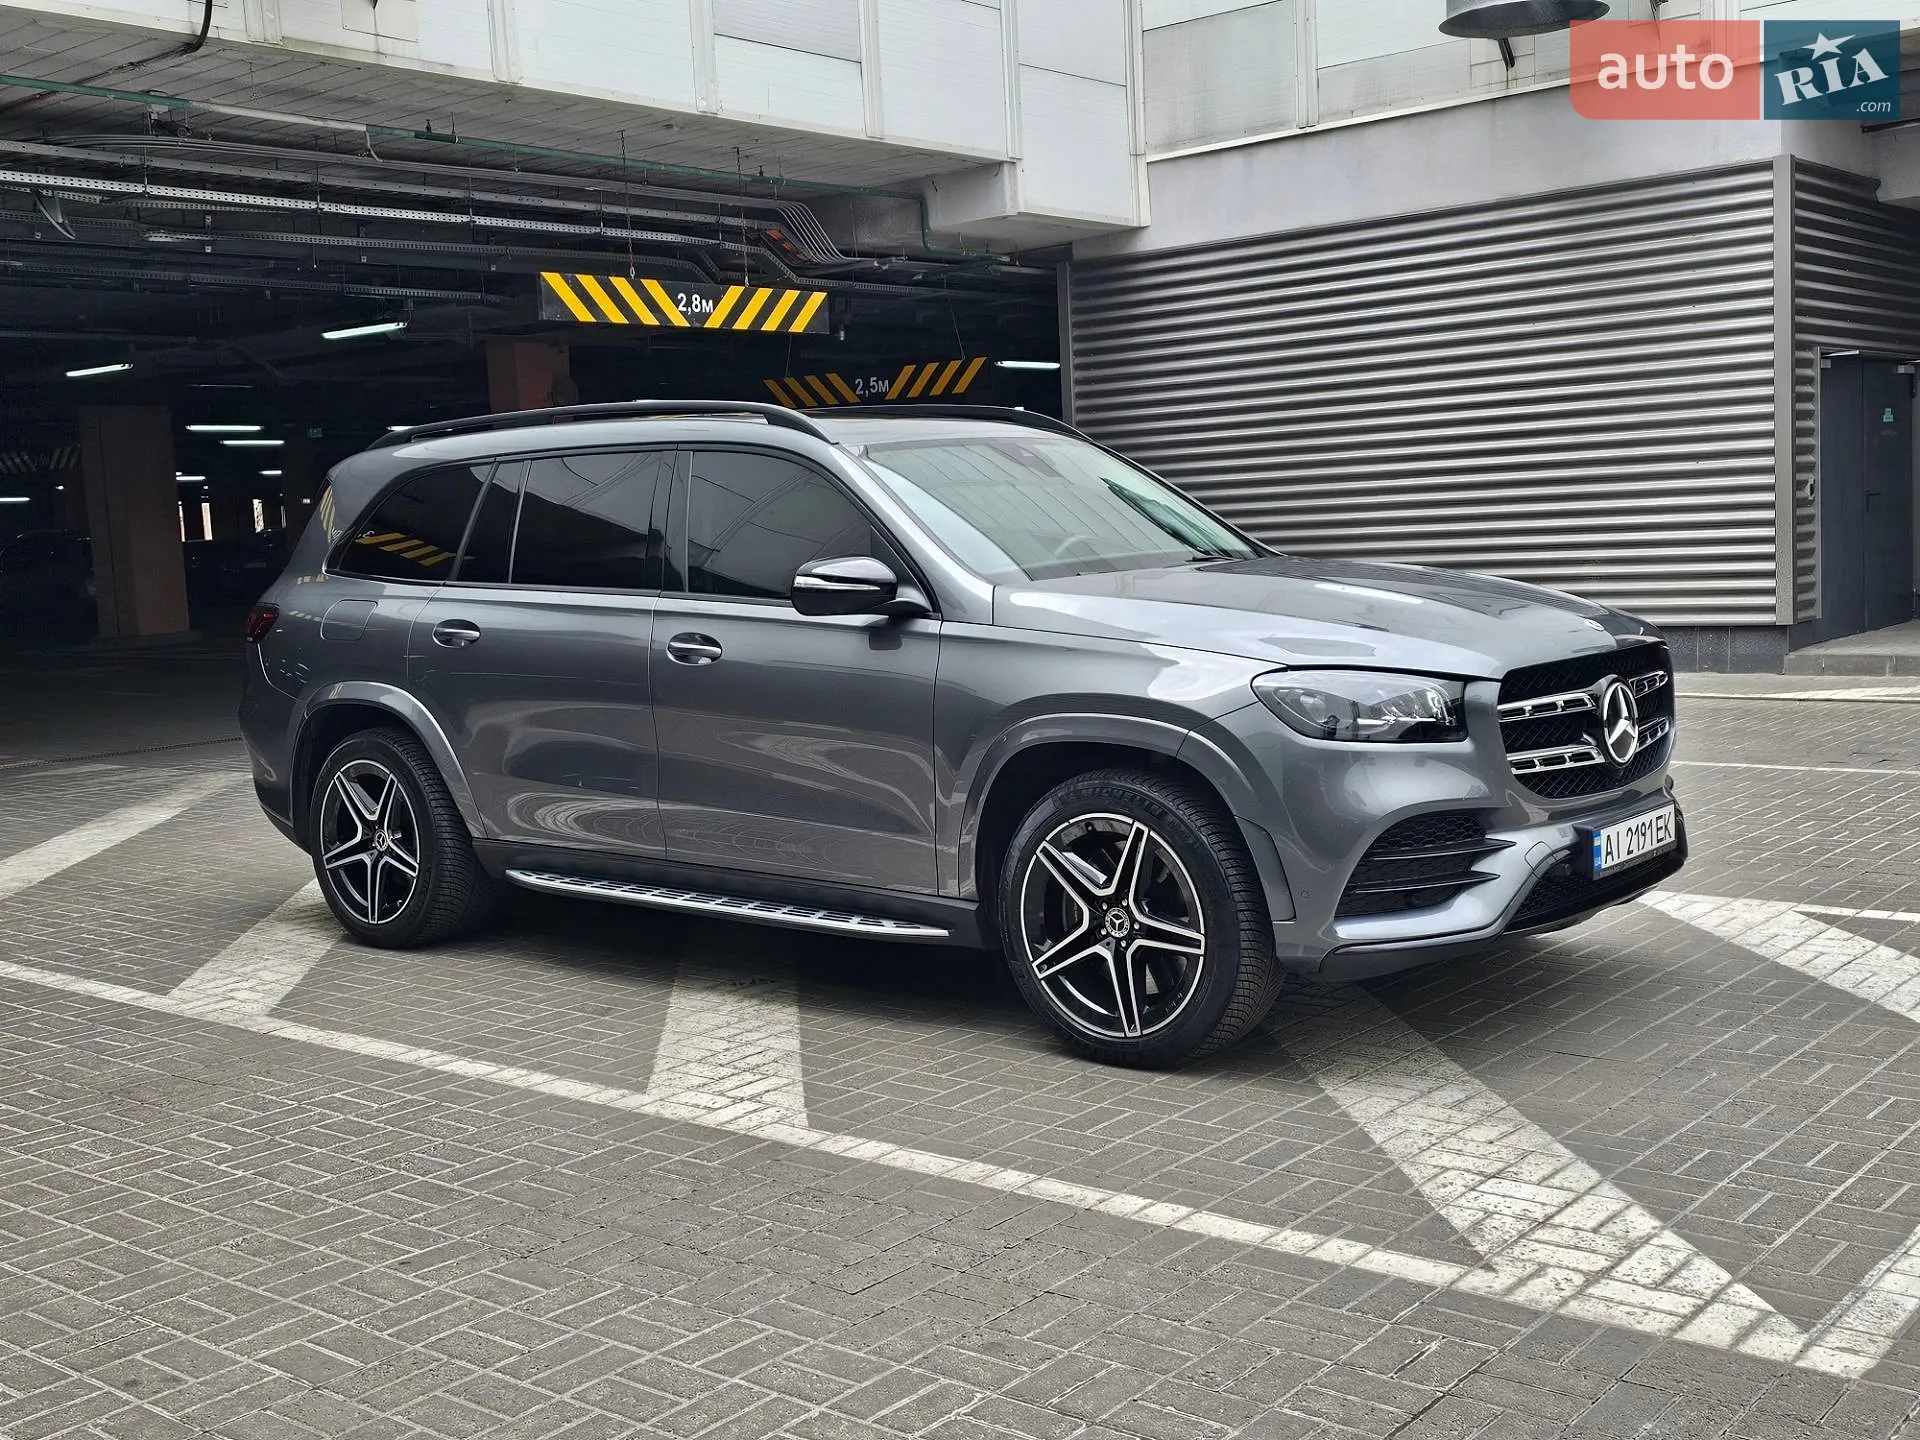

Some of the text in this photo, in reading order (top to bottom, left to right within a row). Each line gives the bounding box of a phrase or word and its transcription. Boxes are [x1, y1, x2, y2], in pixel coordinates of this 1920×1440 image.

[1604, 831, 1621, 864] AI
[1626, 818, 1653, 856] 2191
[1655, 811, 1672, 844] EK
